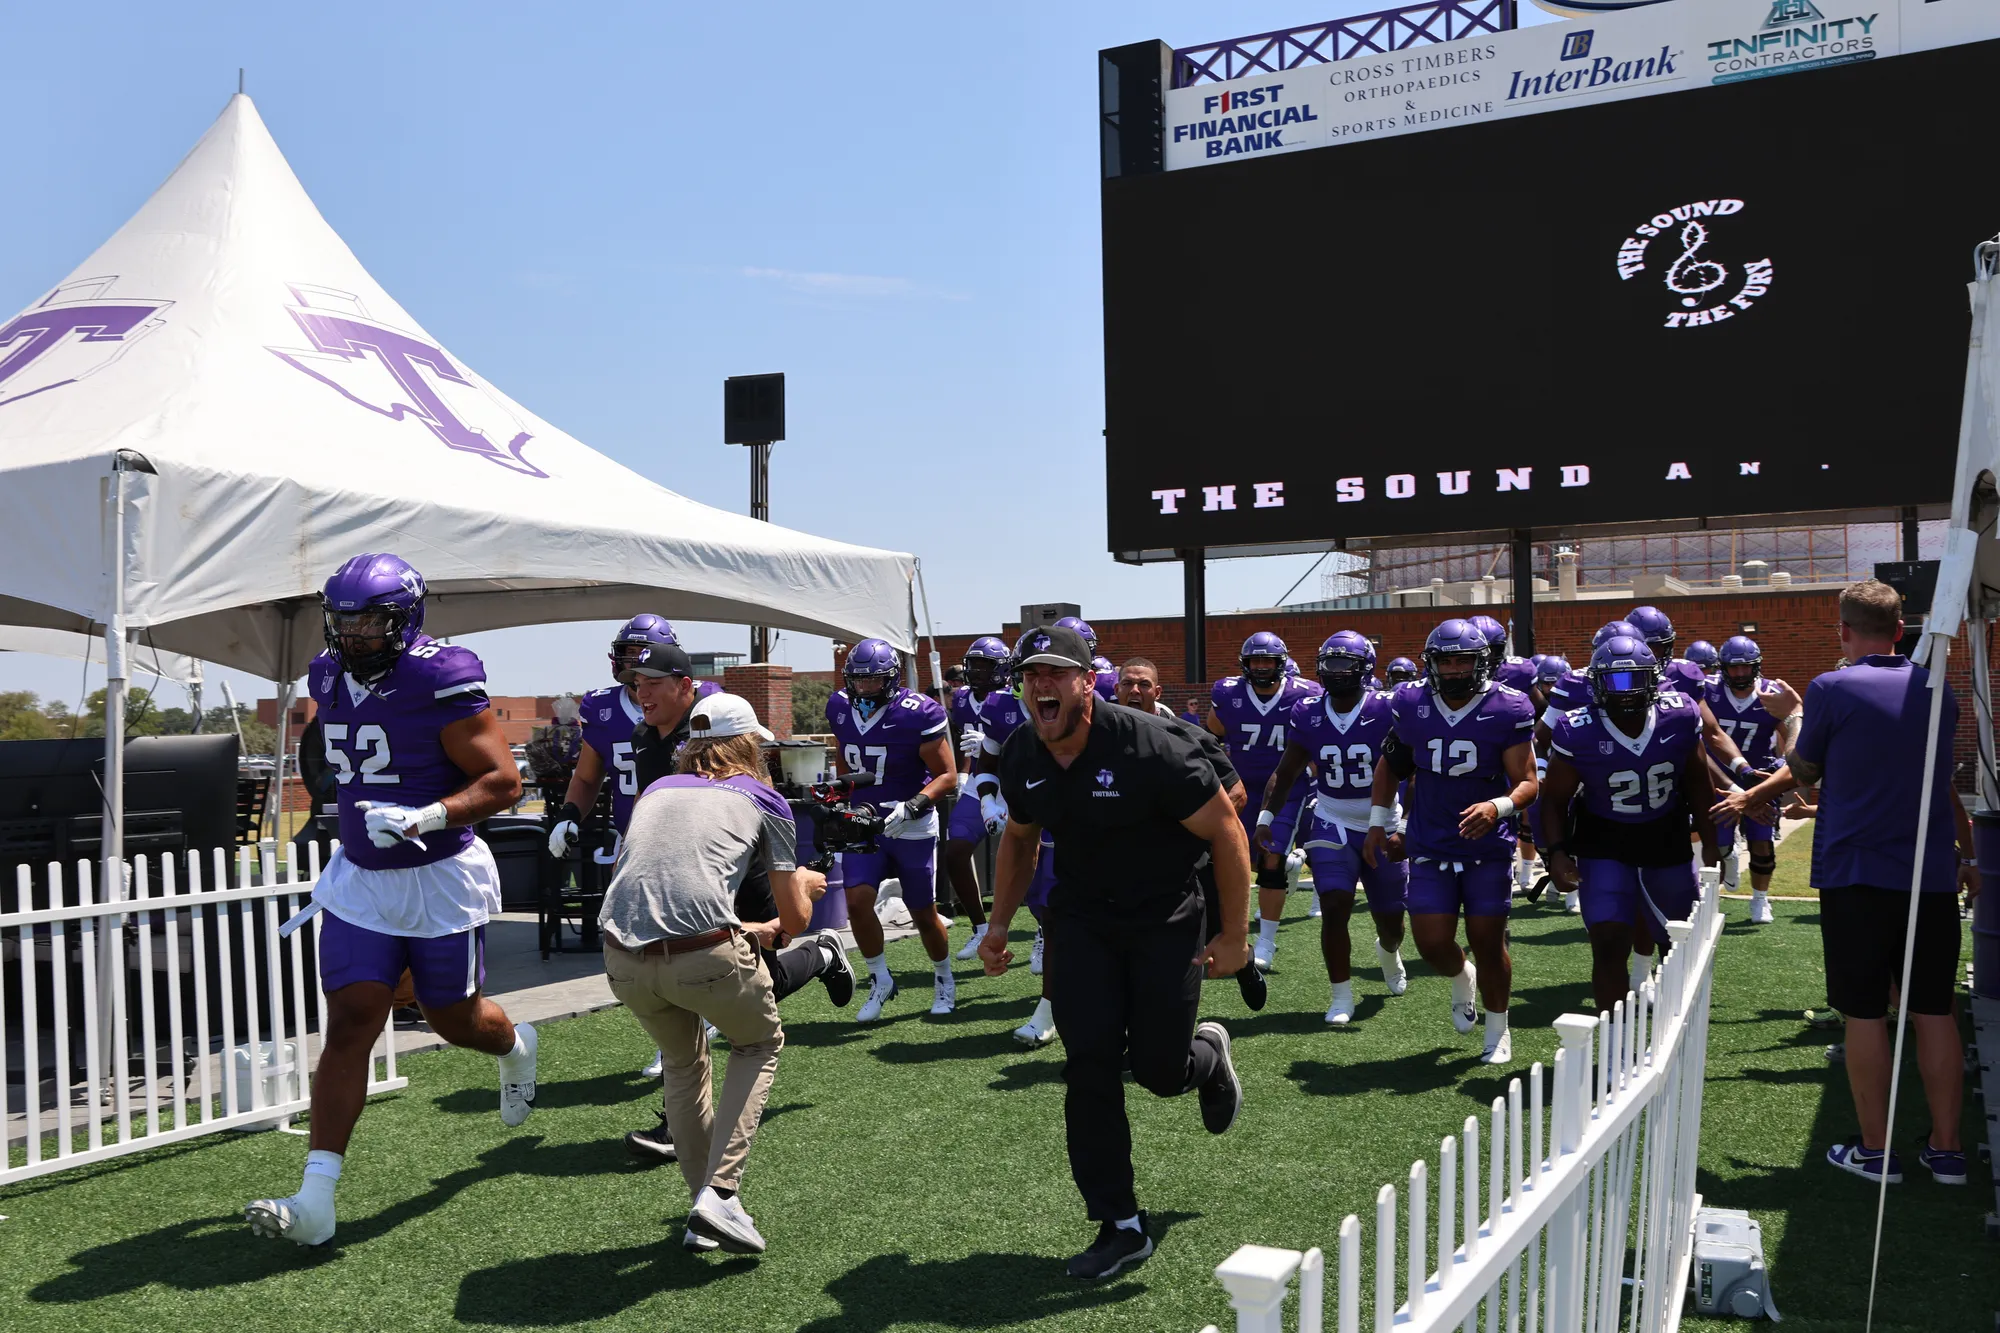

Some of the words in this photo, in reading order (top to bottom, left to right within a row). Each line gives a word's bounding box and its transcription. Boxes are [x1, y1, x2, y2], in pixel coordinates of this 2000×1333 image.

[1563, 34, 1590, 58] IB
[1707, 13, 1879, 61] INFINITY
[1714, 36, 1873, 73] CONTRACTORS
[1330, 62, 1394, 86] CROSS
[1401, 45, 1496, 74] TIMBERS
[1505, 45, 1678, 101] InterBank
[1344, 69, 1481, 103] ORTHOPAEDICS
[1405, 100, 1416, 111] &
[1174, 104, 1318, 143] FINANCIAL
[1331, 117, 1396, 138] SPORTS
[1403, 101, 1494, 126] MEDICINE
[1206, 129, 1284, 159] BANK
[1617, 237, 1650, 281] THE
[1636, 199, 1745, 237] SOUND
[1664, 304, 1735, 328] THE
[1728, 257, 1774, 311] FURY
[1151, 482, 1285, 515] THE
[1335, 465, 1590, 503] SOUND
[323, 723, 400, 784] 52
[1241, 723, 1285, 752] 74
[1719, 718, 1759, 752] 77
[844, 743, 888, 786] 97
[1319, 743, 1374, 789] 33
[1427, 738, 1478, 777] 12
[1092, 790, 1120, 798] FOOTBALL
[1608, 761, 1675, 814] 26
[851, 816, 871, 826] RONIN
